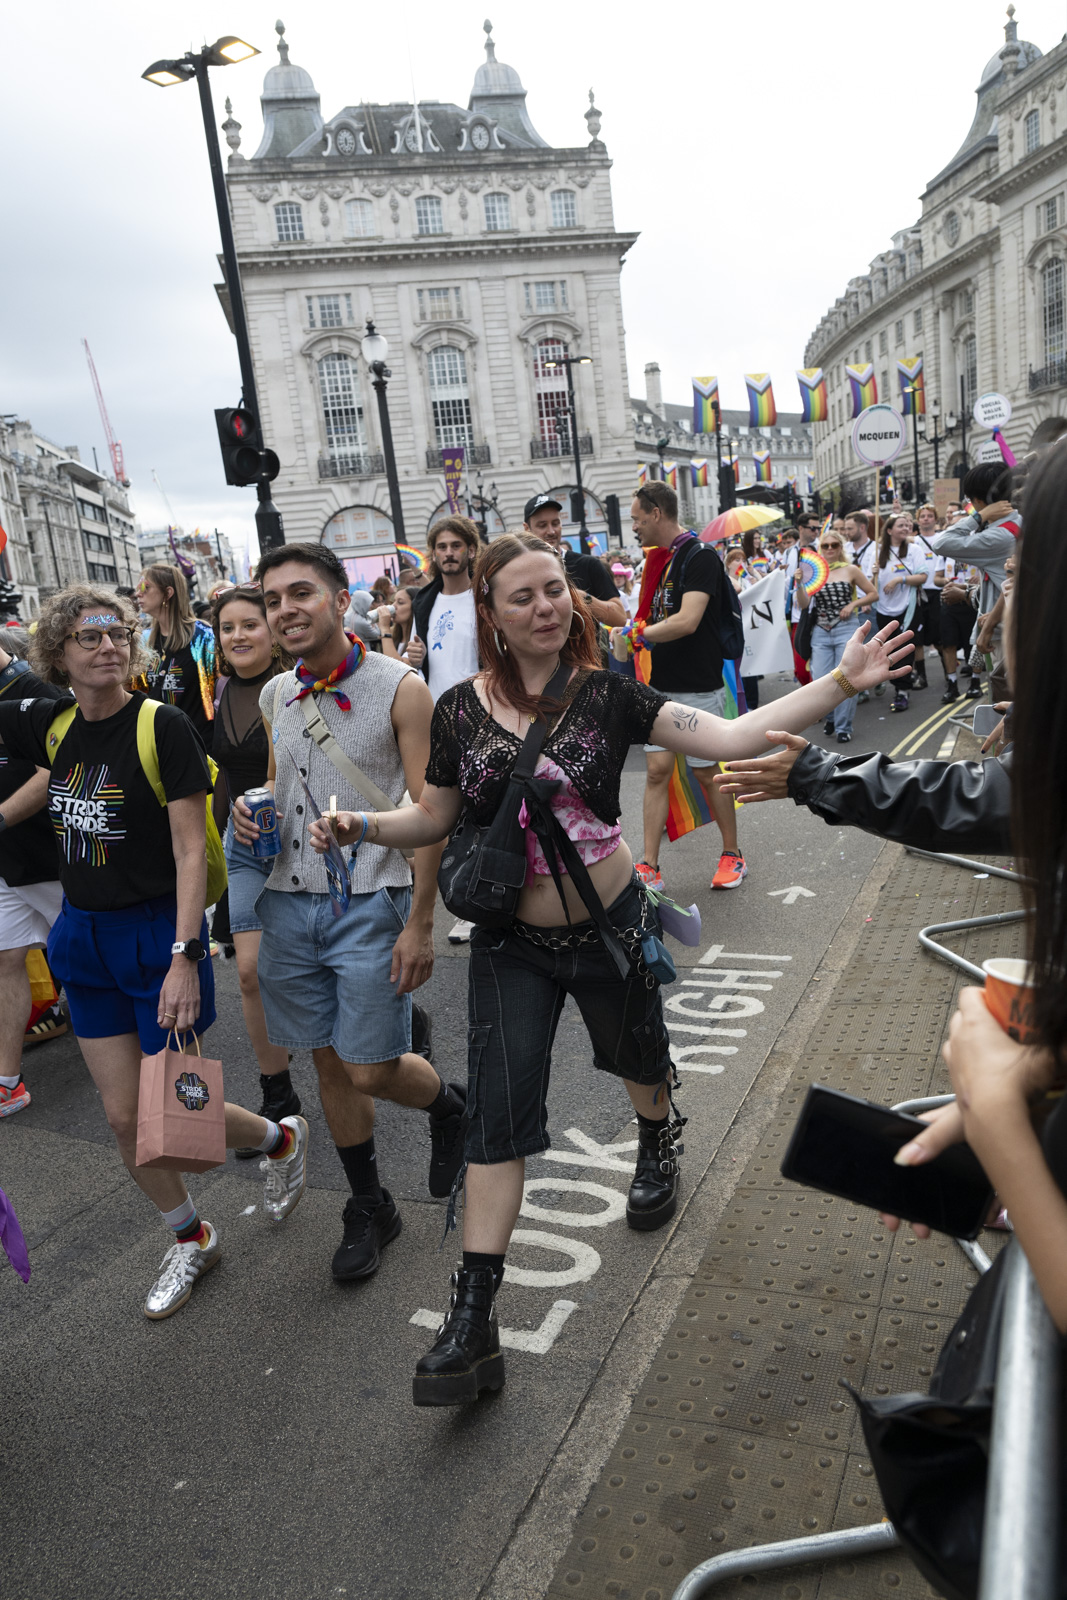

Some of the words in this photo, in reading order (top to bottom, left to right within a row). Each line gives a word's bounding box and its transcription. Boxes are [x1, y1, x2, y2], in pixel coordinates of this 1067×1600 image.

[981, 400, 1001, 409] SOCIAL
[984, 407, 1002, 415] VALUE
[983, 413, 1005, 422] PORTAL
[859, 431, 900, 441] MCQUEEN
[62, 813, 110, 833] PRIDE
[261, 810, 272, 829] F
[408, 1127, 640, 1355] LOOK
